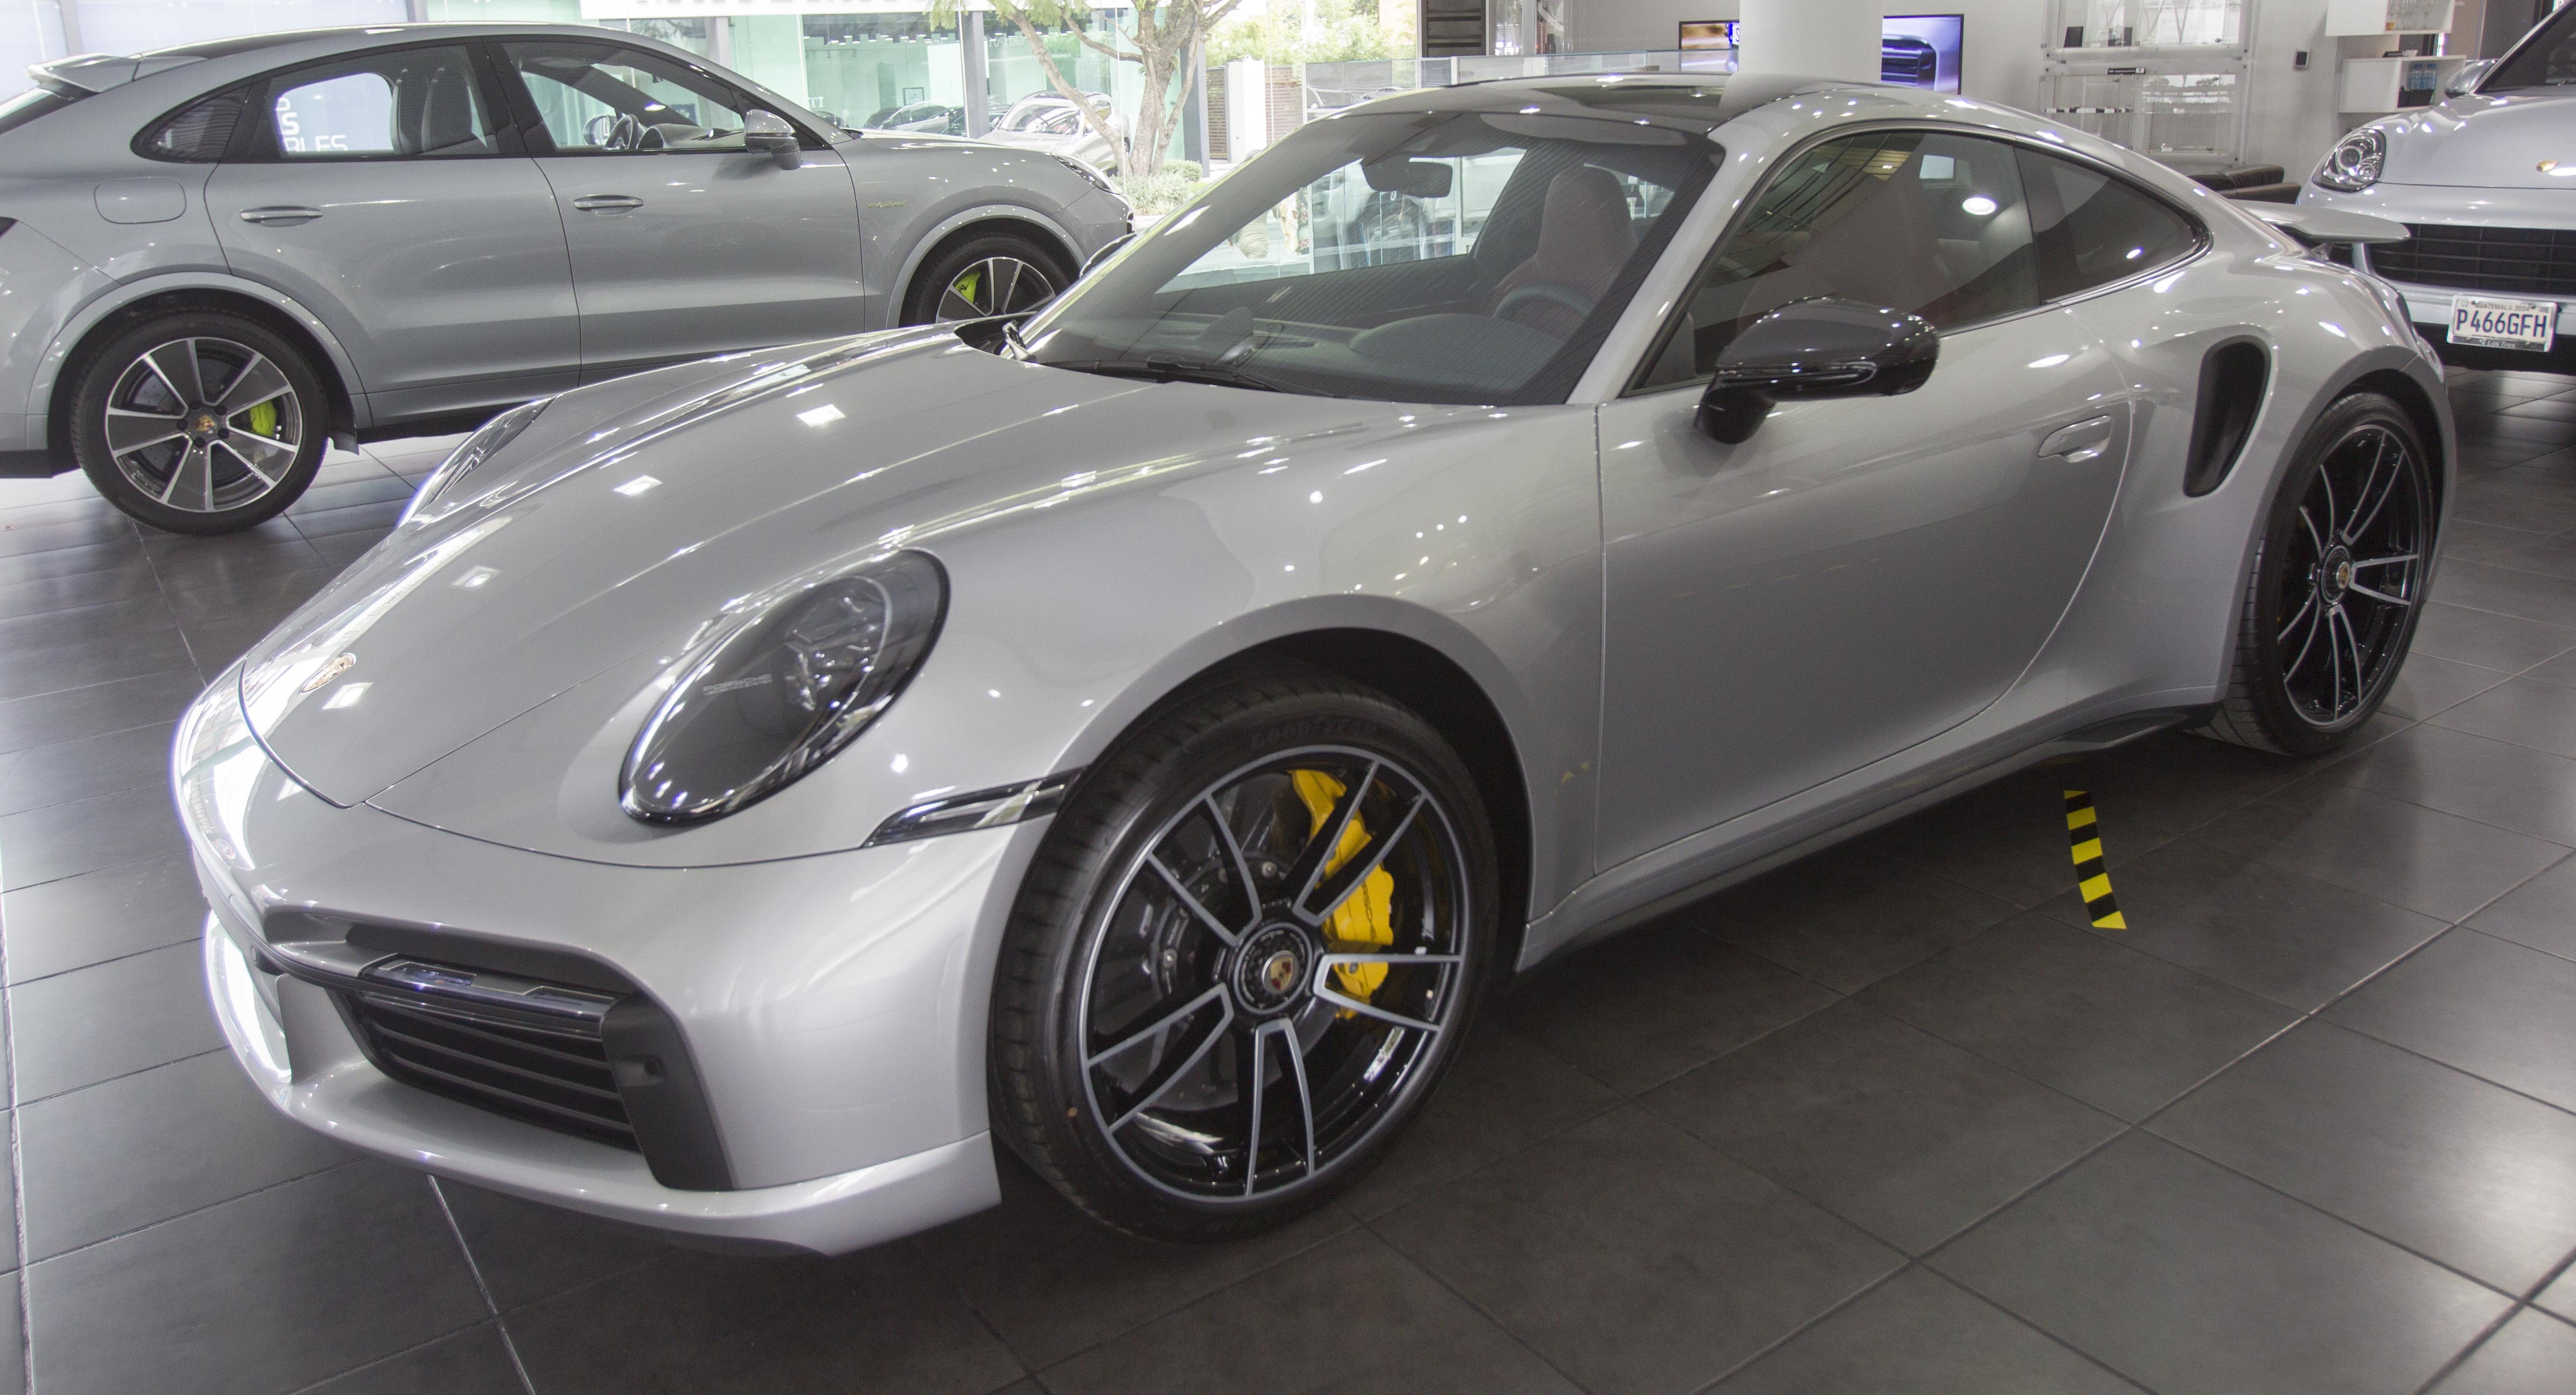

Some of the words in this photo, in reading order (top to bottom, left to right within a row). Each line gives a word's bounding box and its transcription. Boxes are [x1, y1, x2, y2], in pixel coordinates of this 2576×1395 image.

[2455, 309, 2547, 338] P466GFH
[2487, 340, 2499, 348] Los
[2500, 341, 2516, 349] Tres
[703, 673, 772, 694] PORSCHE
